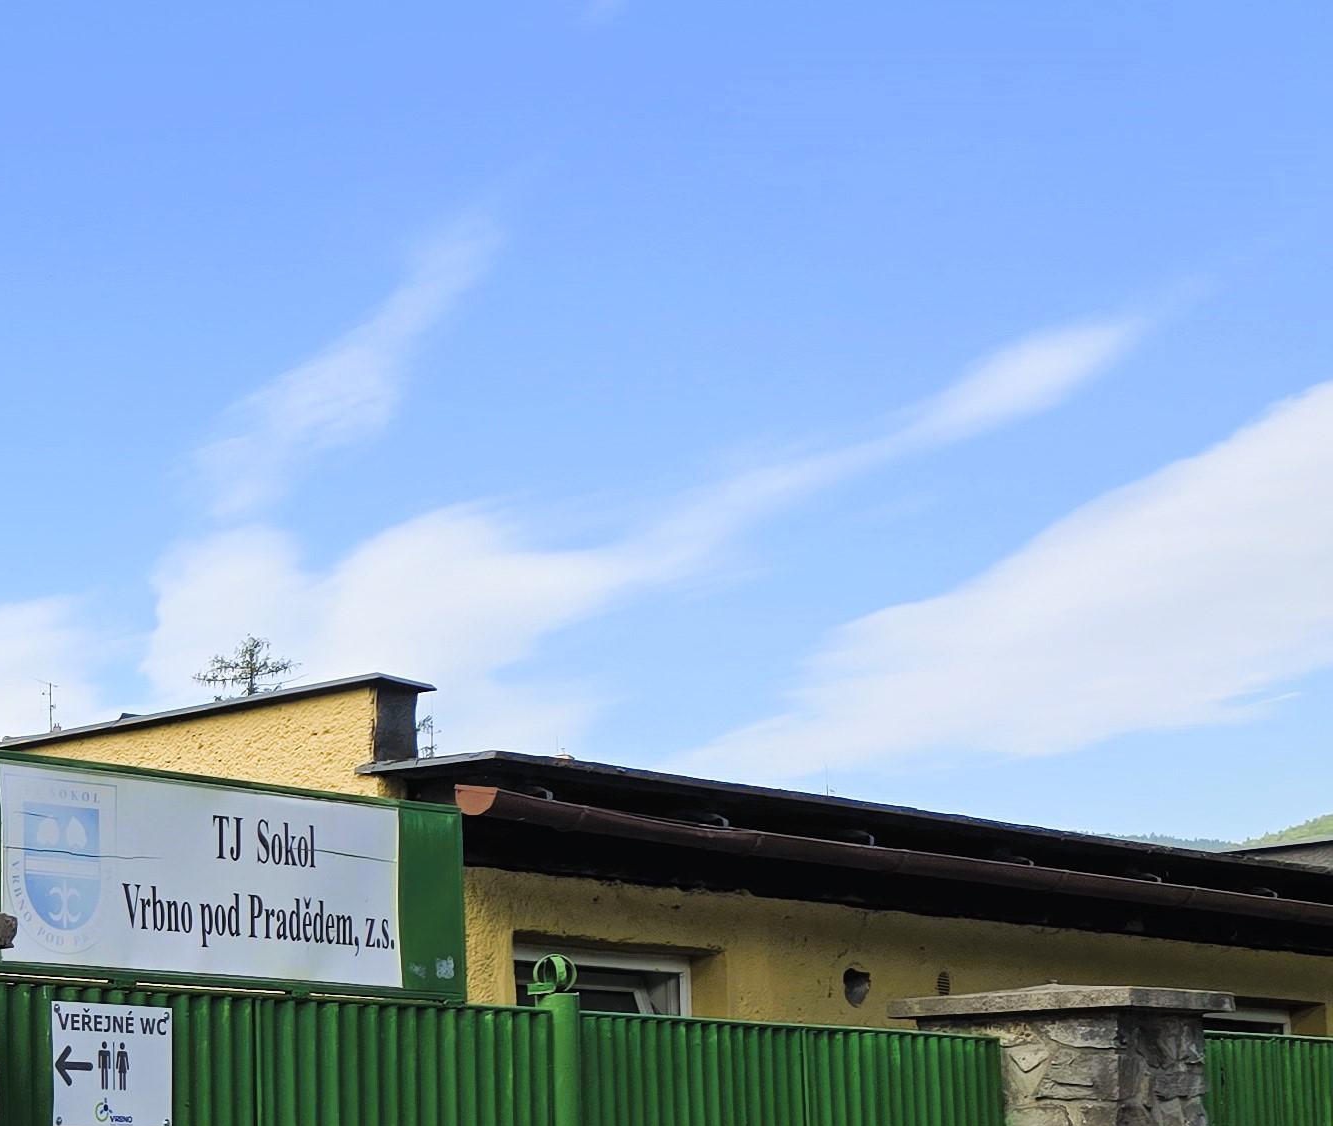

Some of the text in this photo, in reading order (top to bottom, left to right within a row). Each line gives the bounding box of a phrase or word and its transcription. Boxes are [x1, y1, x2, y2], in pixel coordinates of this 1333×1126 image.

[213, 815, 316, 868] TJ Sokol
[121, 883, 396, 956] Vrbno pod Pradědem, z.s.
[58, 1008, 167, 1036] VEŘEJNÉ WC
